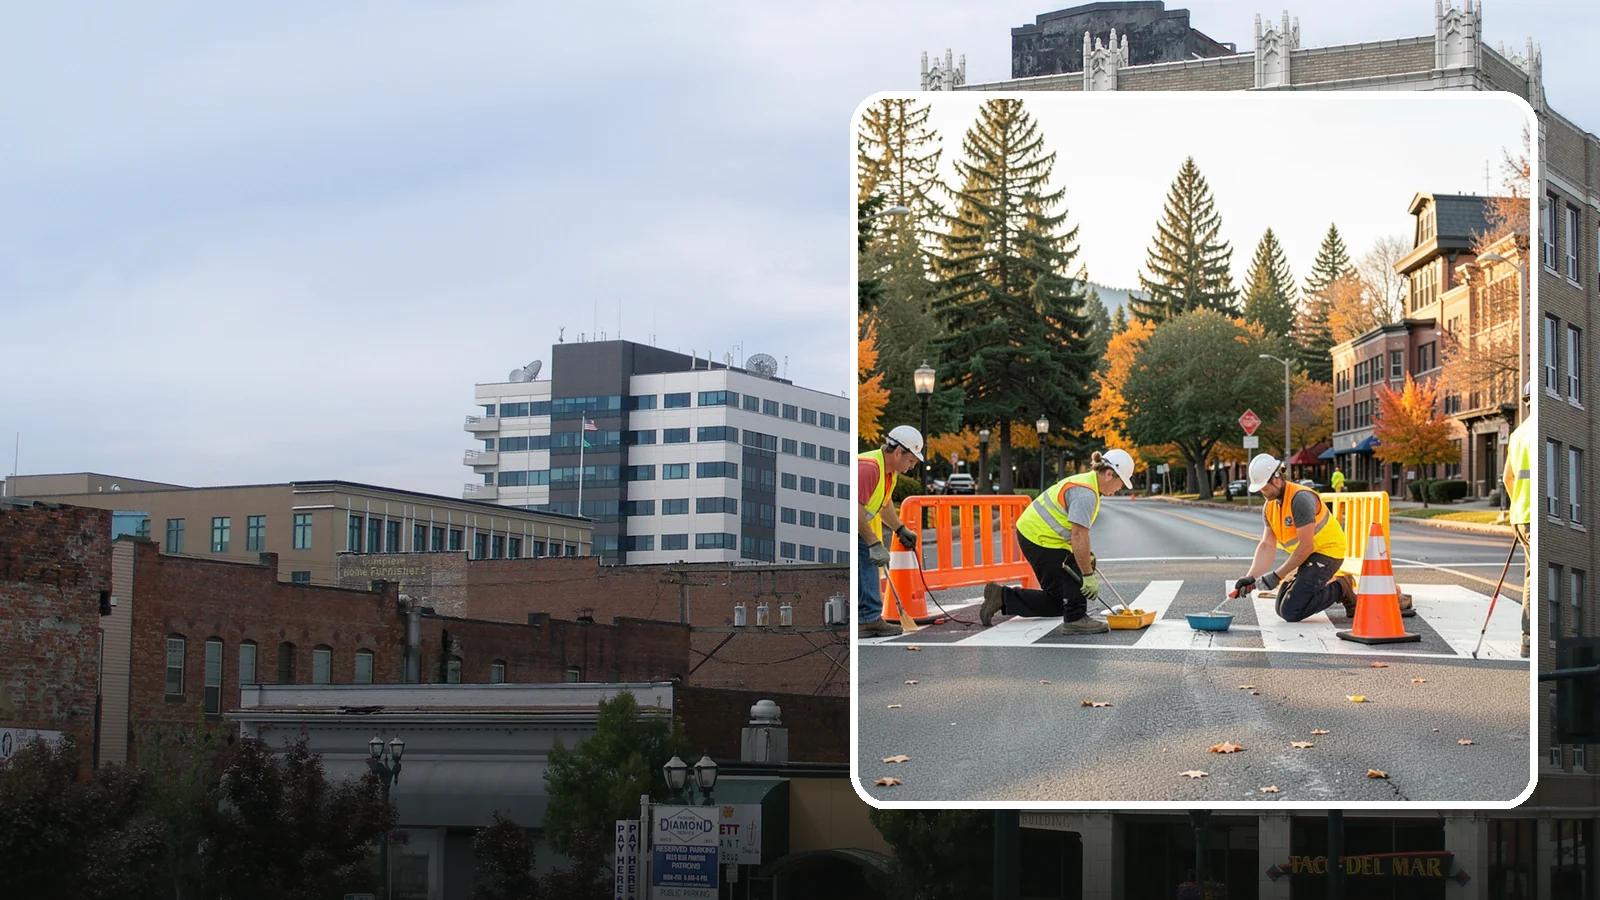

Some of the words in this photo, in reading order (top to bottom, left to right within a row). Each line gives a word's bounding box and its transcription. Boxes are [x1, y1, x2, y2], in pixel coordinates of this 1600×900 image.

[343, 568, 368, 577] Home
[370, 566, 427, 577] Furnishers
[660, 818, 713, 832] DIAMOND
[1022, 815, 1070, 828] BUILDING
[617, 825, 625, 852] PAY
[628, 824, 636, 852] PAY
[656, 845, 688, 853] RESERVED
[689, 846, 716, 854] PARKING
[722, 851, 739, 862] Soup
[671, 862, 701, 870] PATRONS
[1289, 855, 1329, 874] TAC
[1346, 856, 1385, 875] DEL
[1392, 856, 1442, 876] MAR
[616, 855, 625, 893] HERE
[627, 855, 636, 893] HERE
[660, 888, 682, 897] PUBLIC
[684, 890, 710, 898] PARKING
